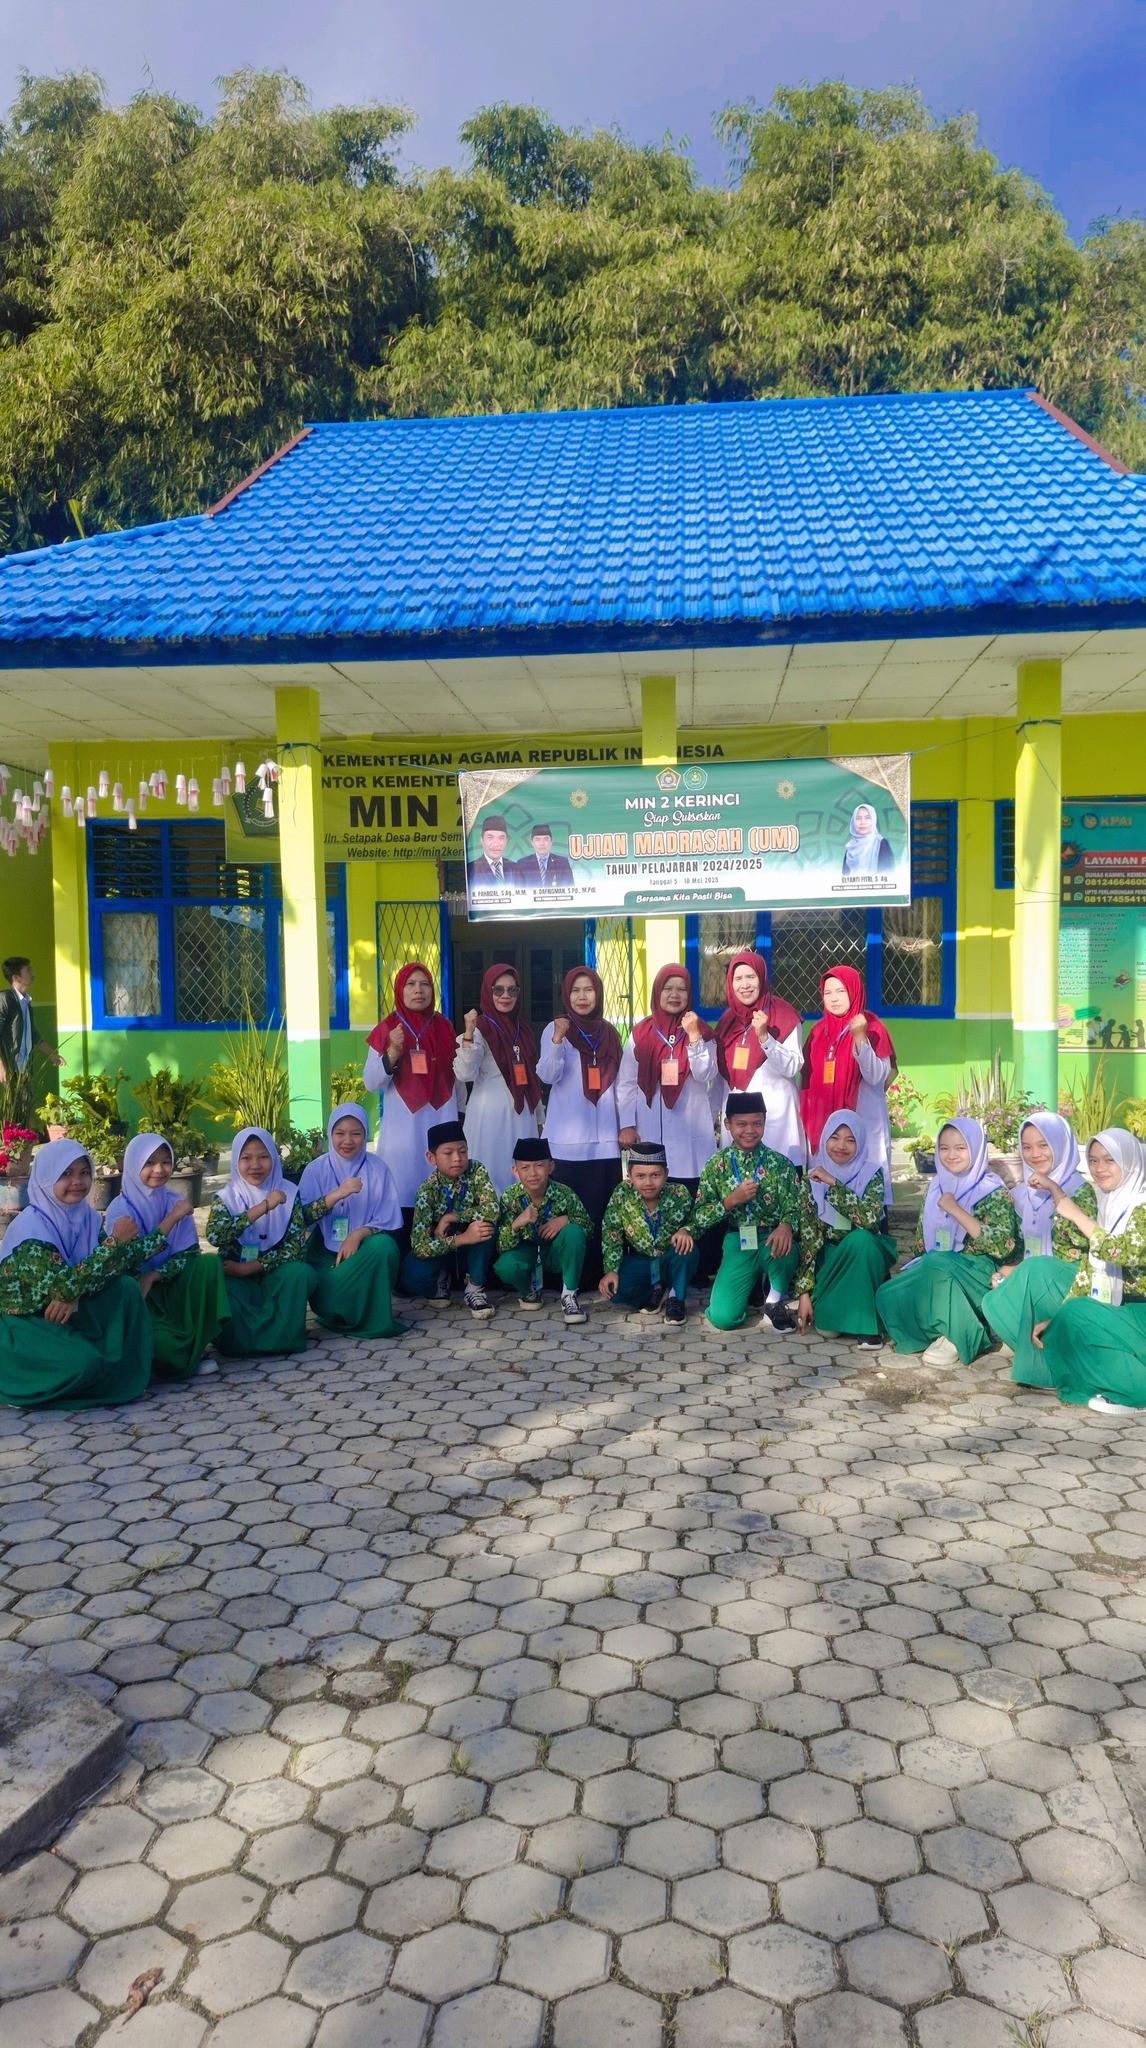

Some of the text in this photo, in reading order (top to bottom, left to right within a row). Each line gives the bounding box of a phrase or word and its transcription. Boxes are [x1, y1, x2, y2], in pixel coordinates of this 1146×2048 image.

[323, 753, 452, 767] KEMENTERIAN
[458, 750, 523, 765] AGAMA
[528, 747, 619, 763] REPUBLIK
[372, 774, 459, 788] KEMENTE
[625, 793, 740, 810] MIN 2 KERINCI
[349, 794, 438, 828] MIN
[643, 809, 722, 827] Siap Sukseskan
[1100, 815, 1133, 828] KPAI
[342, 833, 383, 845] Setapak
[385, 833, 410, 843] Desa
[413, 832, 437, 843] Baru
[440, 831, 464, 843] Sem
[570, 825, 800, 859] UJIAN MADRASAH (UM)
[347, 847, 391, 858] Website:
[606, 858, 763, 876] TAHUN PELAJARAN 2024/2025
[1084, 857, 1138, 865] LAYANAN
[650, 878, 672, 886] Tanggal
[704, 876, 719, 884] 2025
[636, 890, 733, 904] Bersama Kita Pasti Bisa
